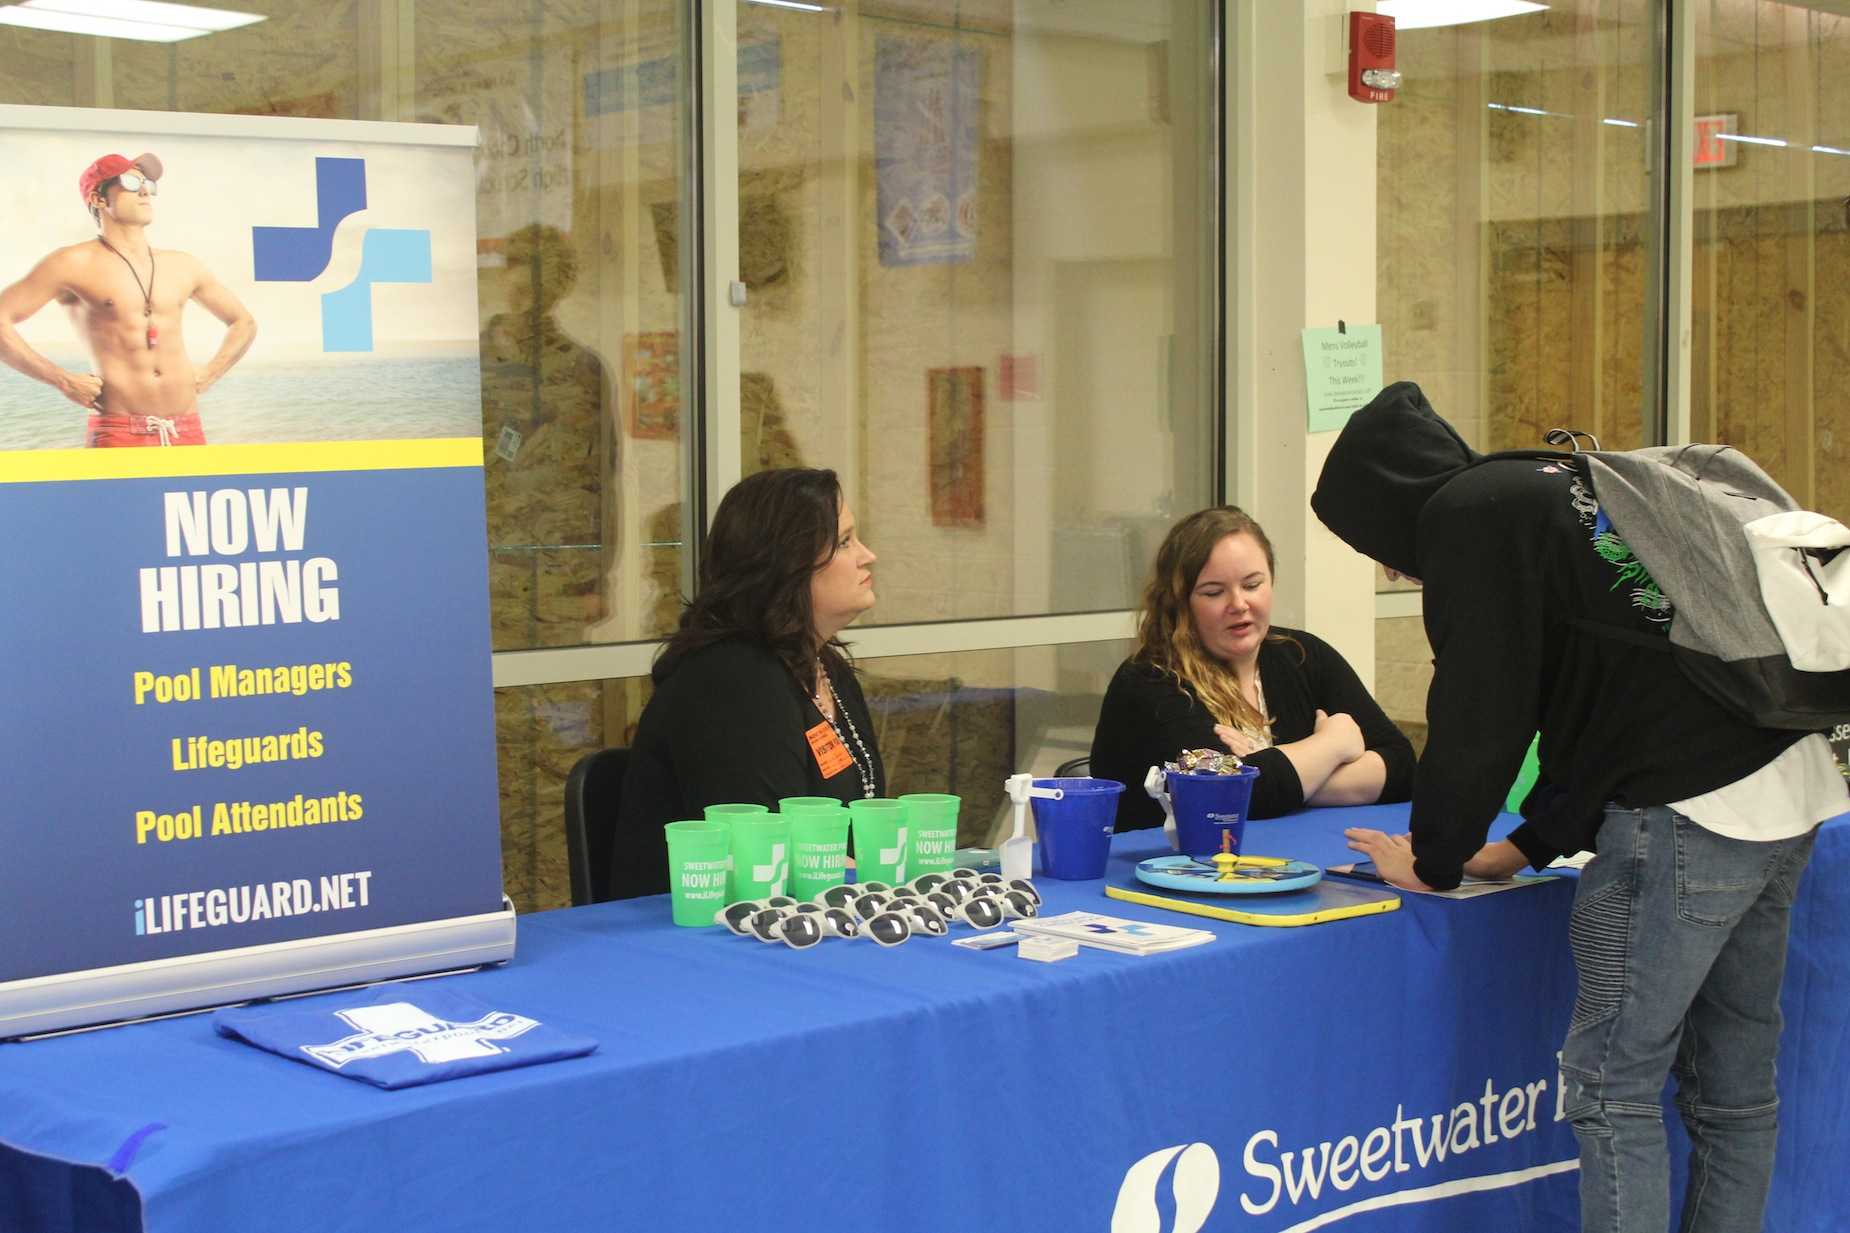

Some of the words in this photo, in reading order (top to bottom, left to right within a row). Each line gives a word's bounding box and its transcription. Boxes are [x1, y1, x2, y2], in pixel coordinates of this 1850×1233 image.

[1370, 91, 1388, 101] FIRE
[164, 487, 308, 557] NOW
[139, 557, 340, 633] HIRING
[134, 667, 200, 705] Pool
[210, 661, 353, 699] Managers
[171, 727, 324, 771] Lifeguards
[136, 805, 202, 844] Pool
[211, 791, 364, 836] Attendants
[916, 841, 942, 854] NOW
[134, 871, 372, 936] iLIFEGUARD.NET
[681, 873, 711, 888] NOW
[1240, 1078, 1546, 1215] Sweetwater
